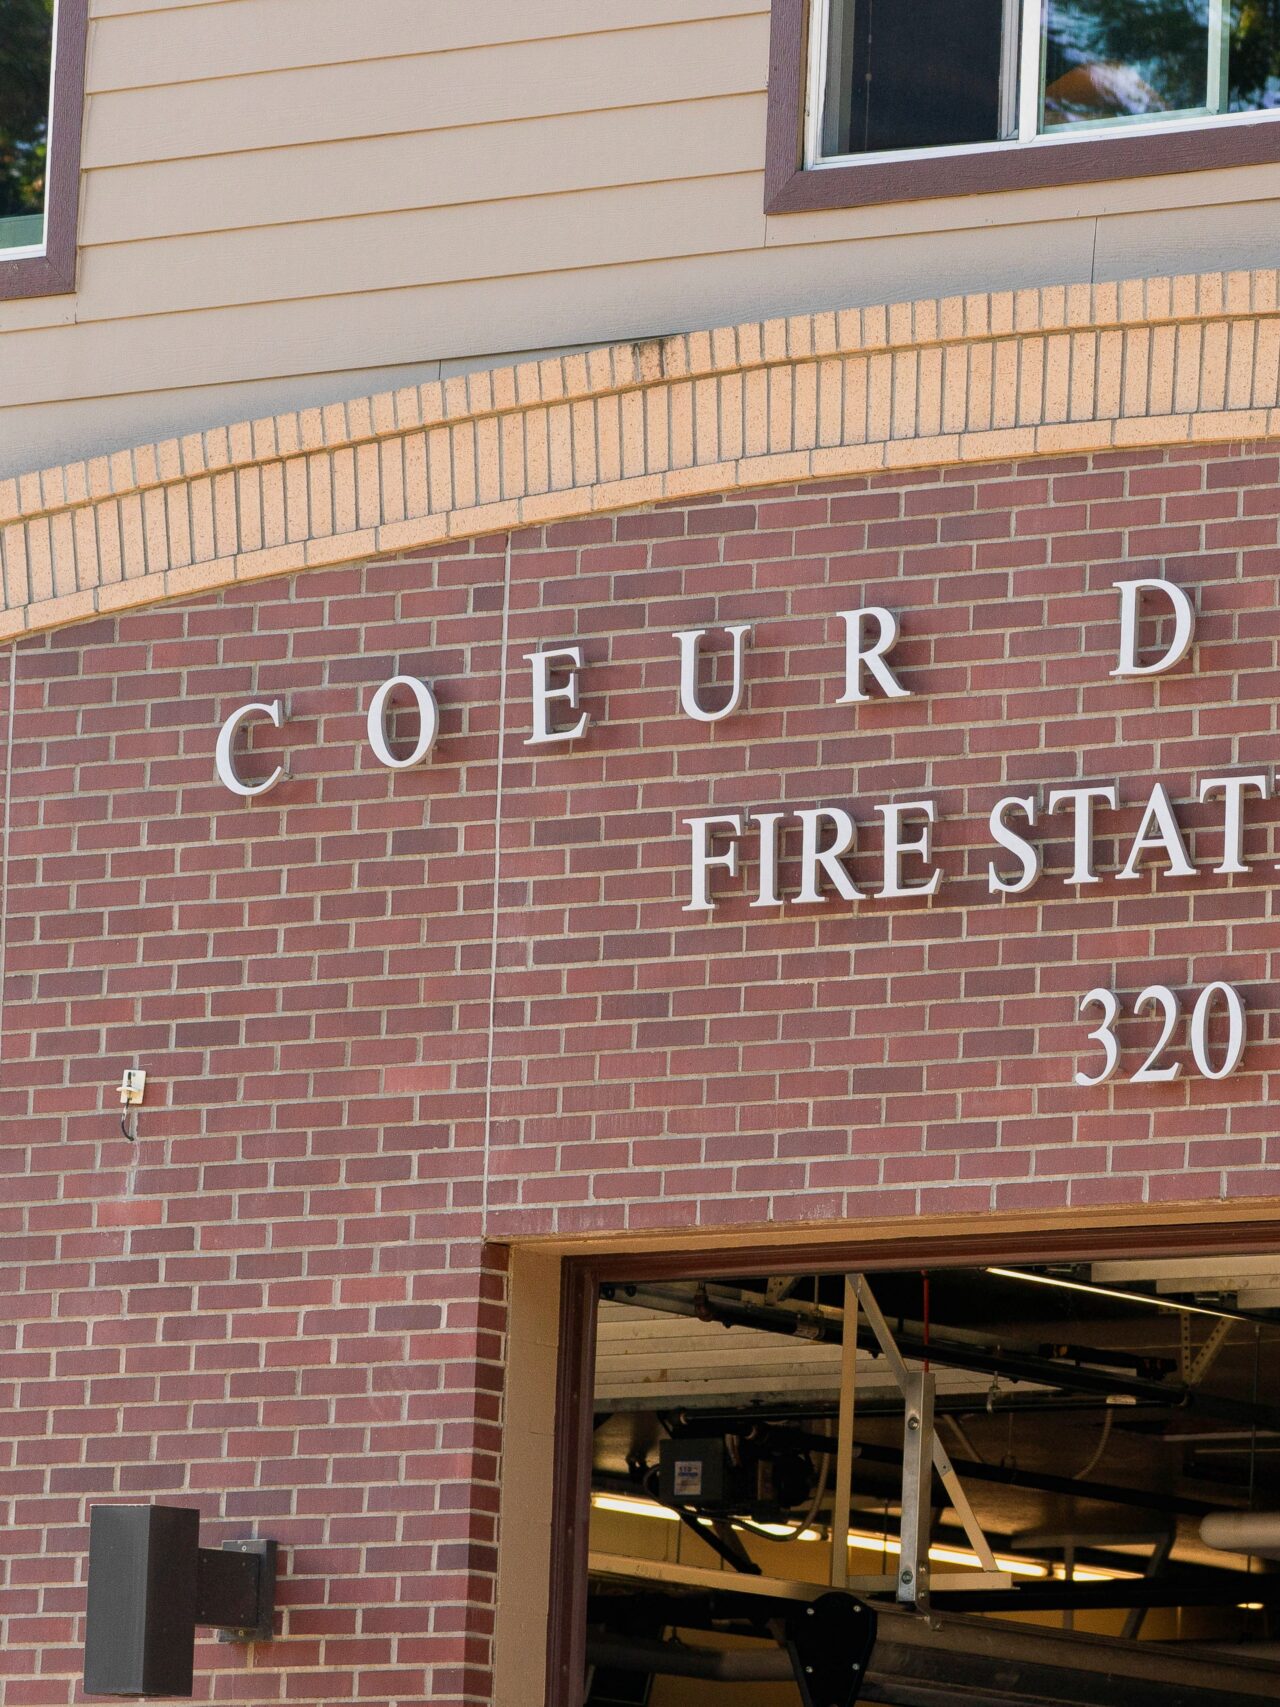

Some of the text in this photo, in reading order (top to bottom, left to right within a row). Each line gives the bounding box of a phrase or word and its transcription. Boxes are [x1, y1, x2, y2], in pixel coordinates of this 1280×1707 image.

[216, 606, 911, 796] COEUR
[682, 800, 943, 911] FIRE
[1075, 982, 1246, 1086] 320
